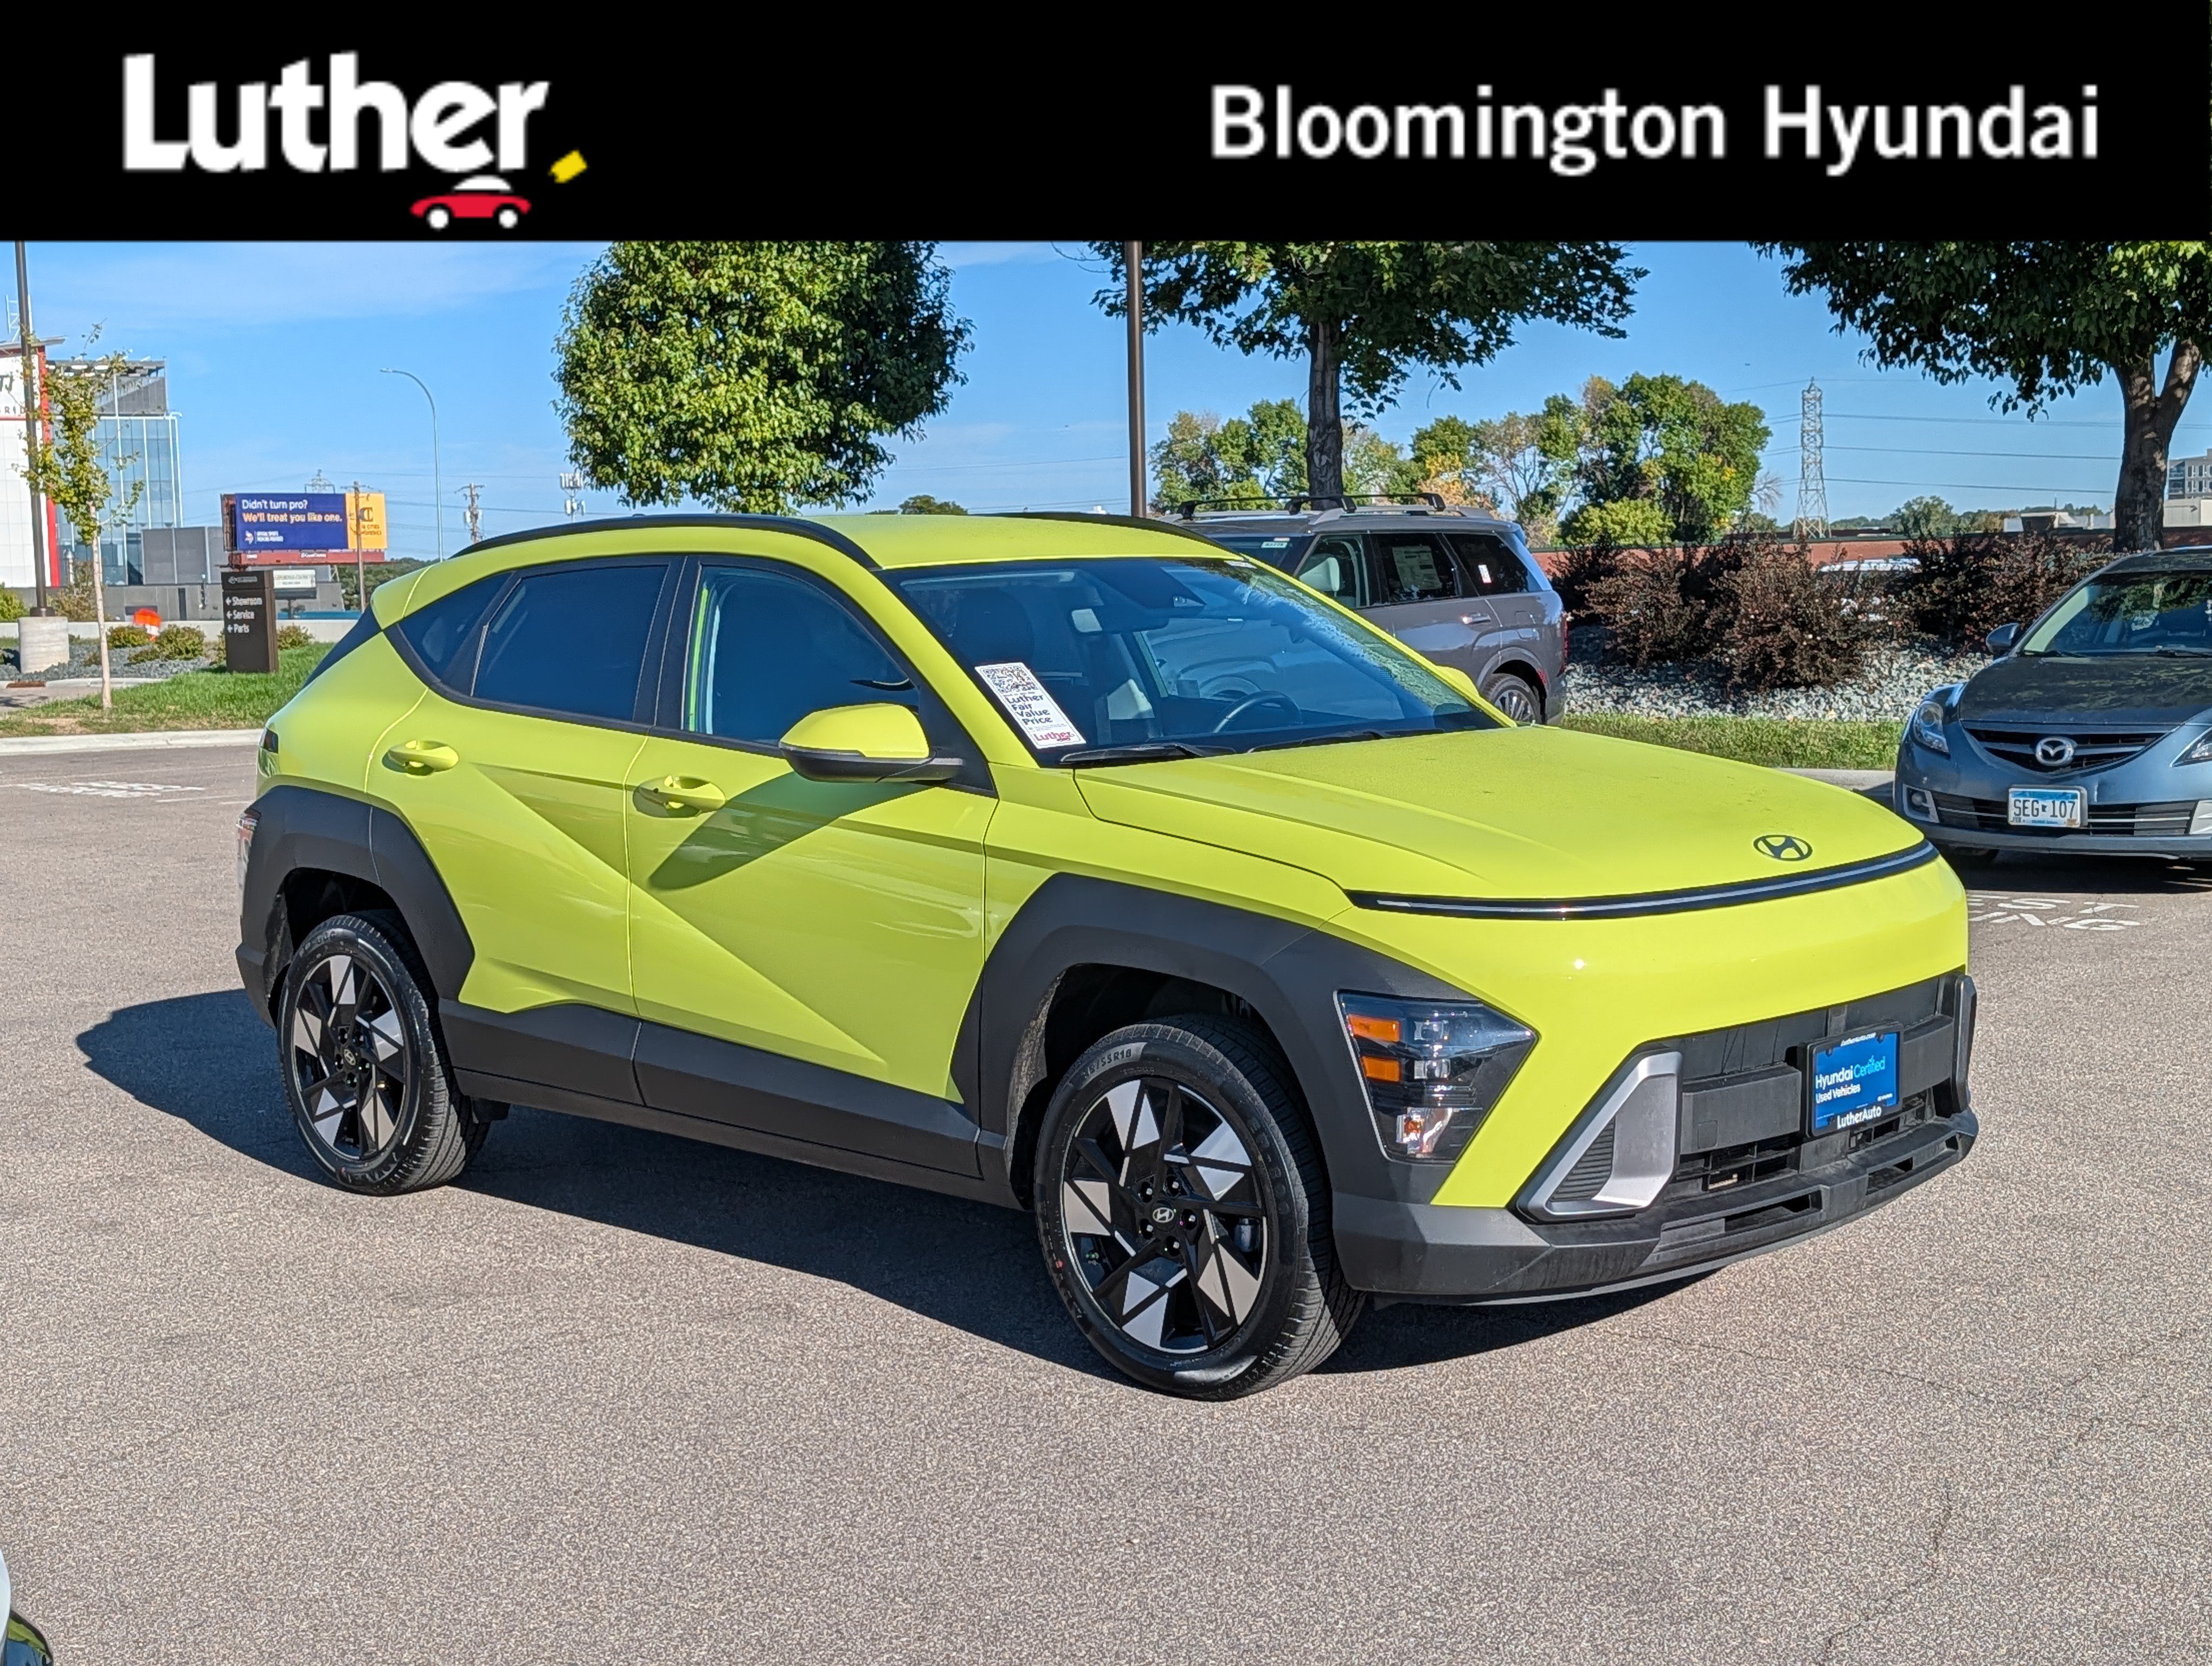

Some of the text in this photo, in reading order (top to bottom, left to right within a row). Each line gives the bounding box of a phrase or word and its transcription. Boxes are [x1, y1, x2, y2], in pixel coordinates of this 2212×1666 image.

[242, 499, 308, 511] Didn't turn pro?
[242, 512, 343, 524] We'll treat you like one.
[232, 597, 262, 606] Showroom
[233, 610, 255, 619] Service
[234, 624, 249, 633] Parts
[1005, 694, 1044, 704] Luther
[1017, 709, 1051, 717] Value
[1022, 716, 1053, 726] Price
[1033, 731, 1072, 742] Luther
[2013, 799, 2076, 818] SEG 107
[1816, 1055, 1886, 1090] Hyundai Certified
[1816, 1090, 1832, 1104] Used
[1832, 1084, 1861, 1099] Vehicles
[1837, 1105, 1882, 1129] LutherAuto
